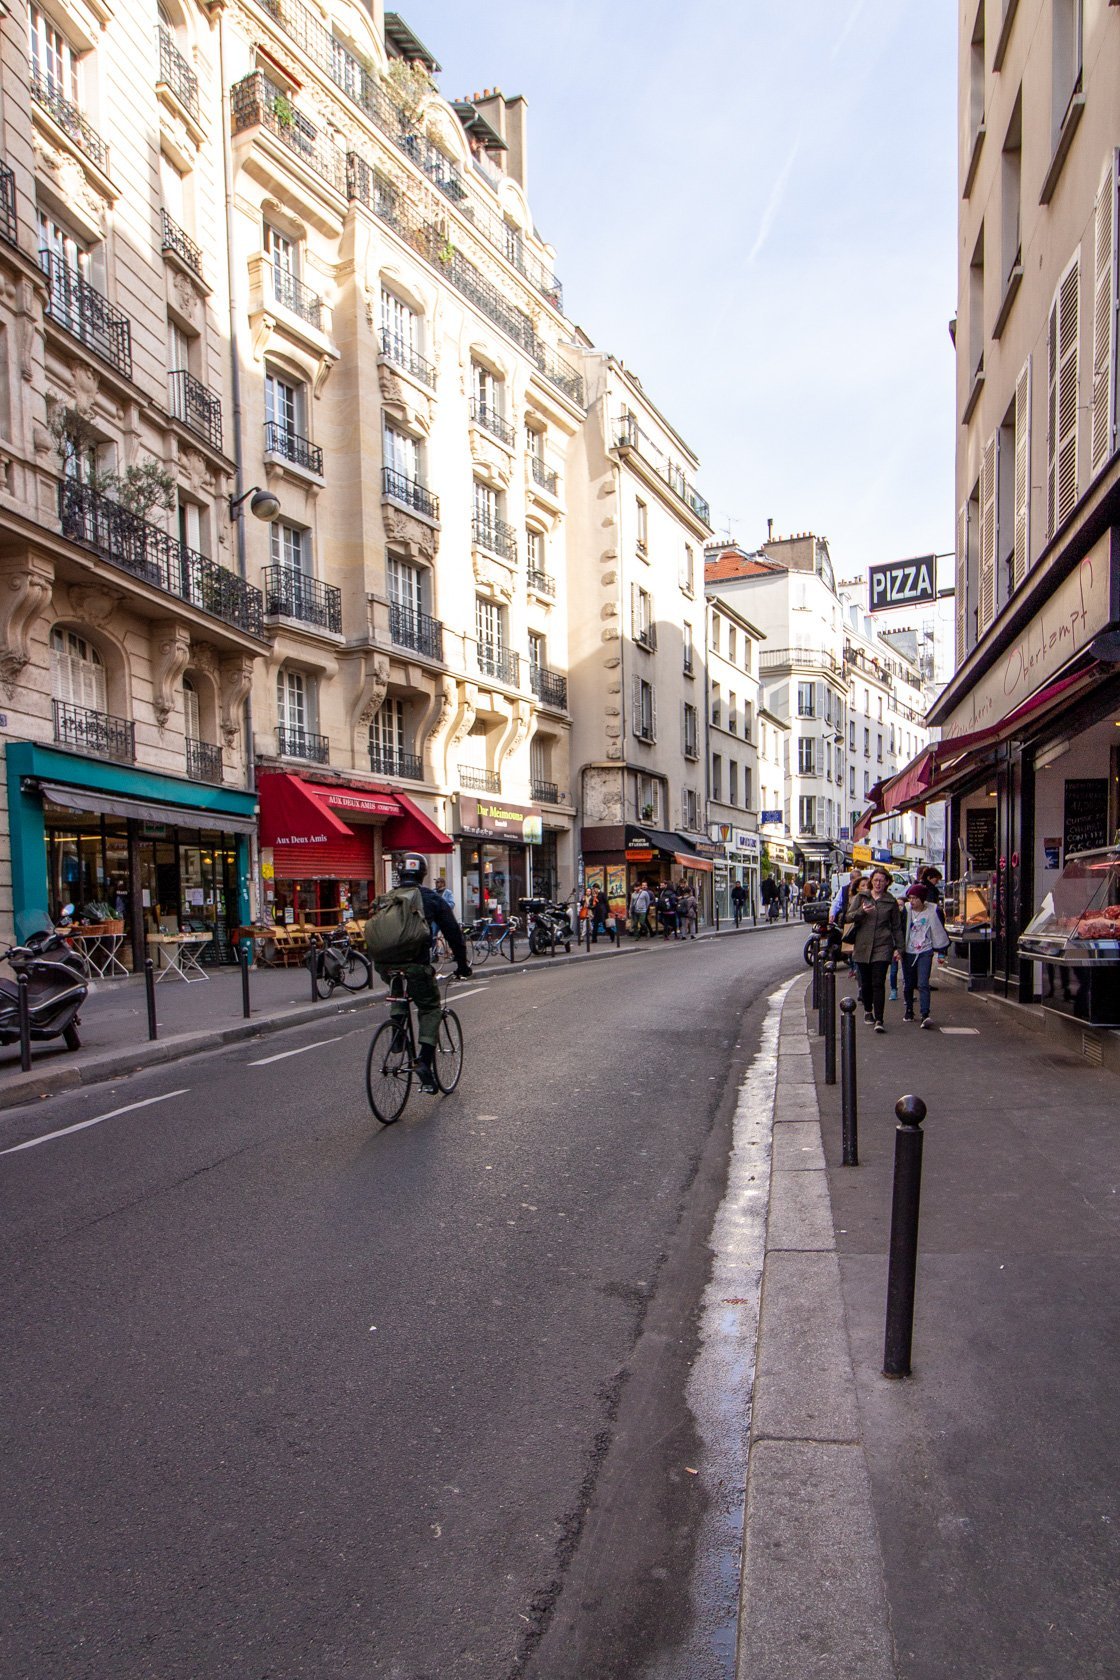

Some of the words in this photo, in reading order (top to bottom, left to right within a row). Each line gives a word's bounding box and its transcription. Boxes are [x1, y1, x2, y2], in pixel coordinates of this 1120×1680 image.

[873, 564, 932, 604] PIZZA
[1004, 557, 1093, 697] Oberkampf
[329, 796, 343, 805] AUX
[343, 798, 360, 808] DEUX
[360, 801, 376, 810] AMIS
[276, 836, 290, 844] Aux
[291, 835, 309, 844] Deux
[310, 834, 328, 843] Amis
